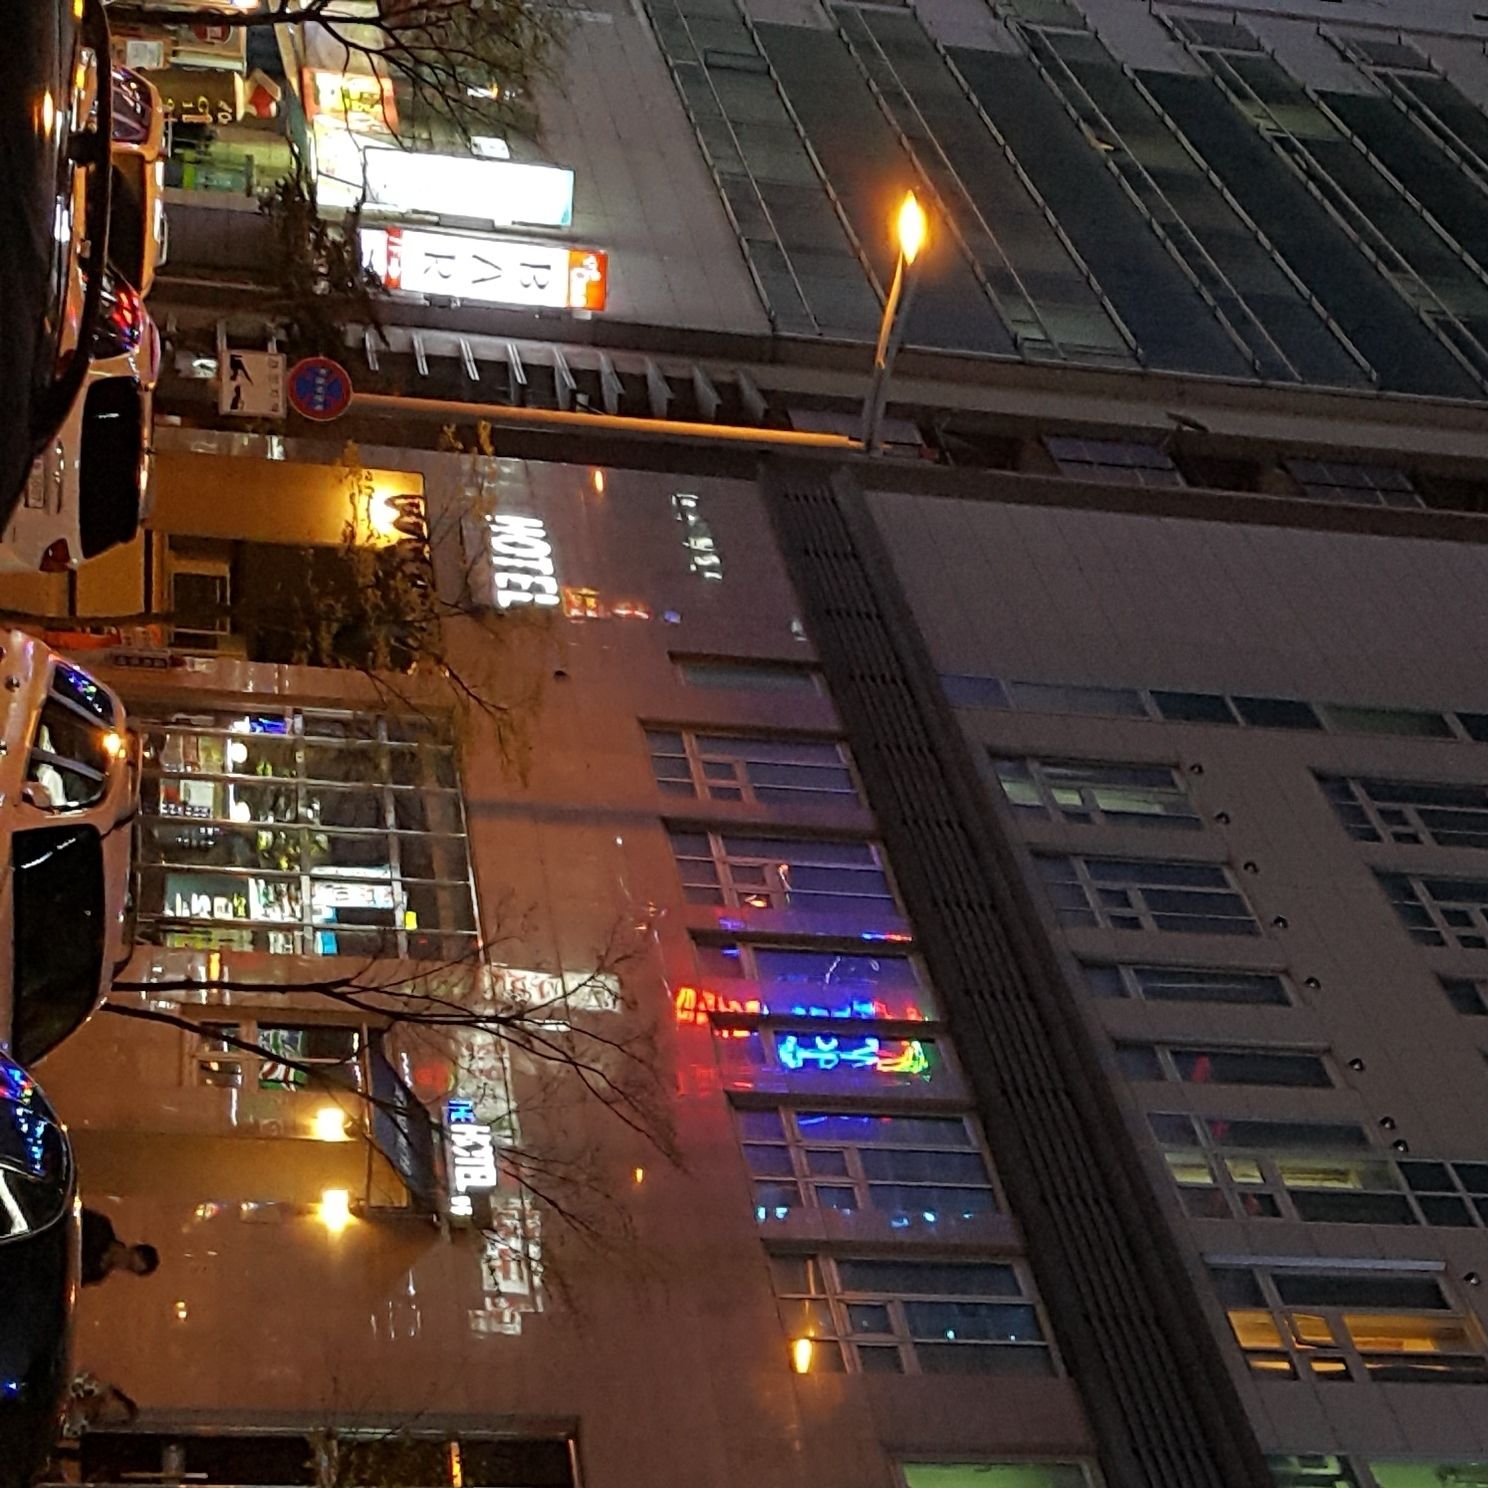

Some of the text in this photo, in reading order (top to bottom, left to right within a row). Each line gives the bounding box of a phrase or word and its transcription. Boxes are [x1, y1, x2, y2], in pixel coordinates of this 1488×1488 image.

[423, 252, 552, 290] BAR
[485, 515, 560, 608] HOTEL
[448, 1100, 475, 1123] THE
[451, 1124, 496, 1193] HOTEL
